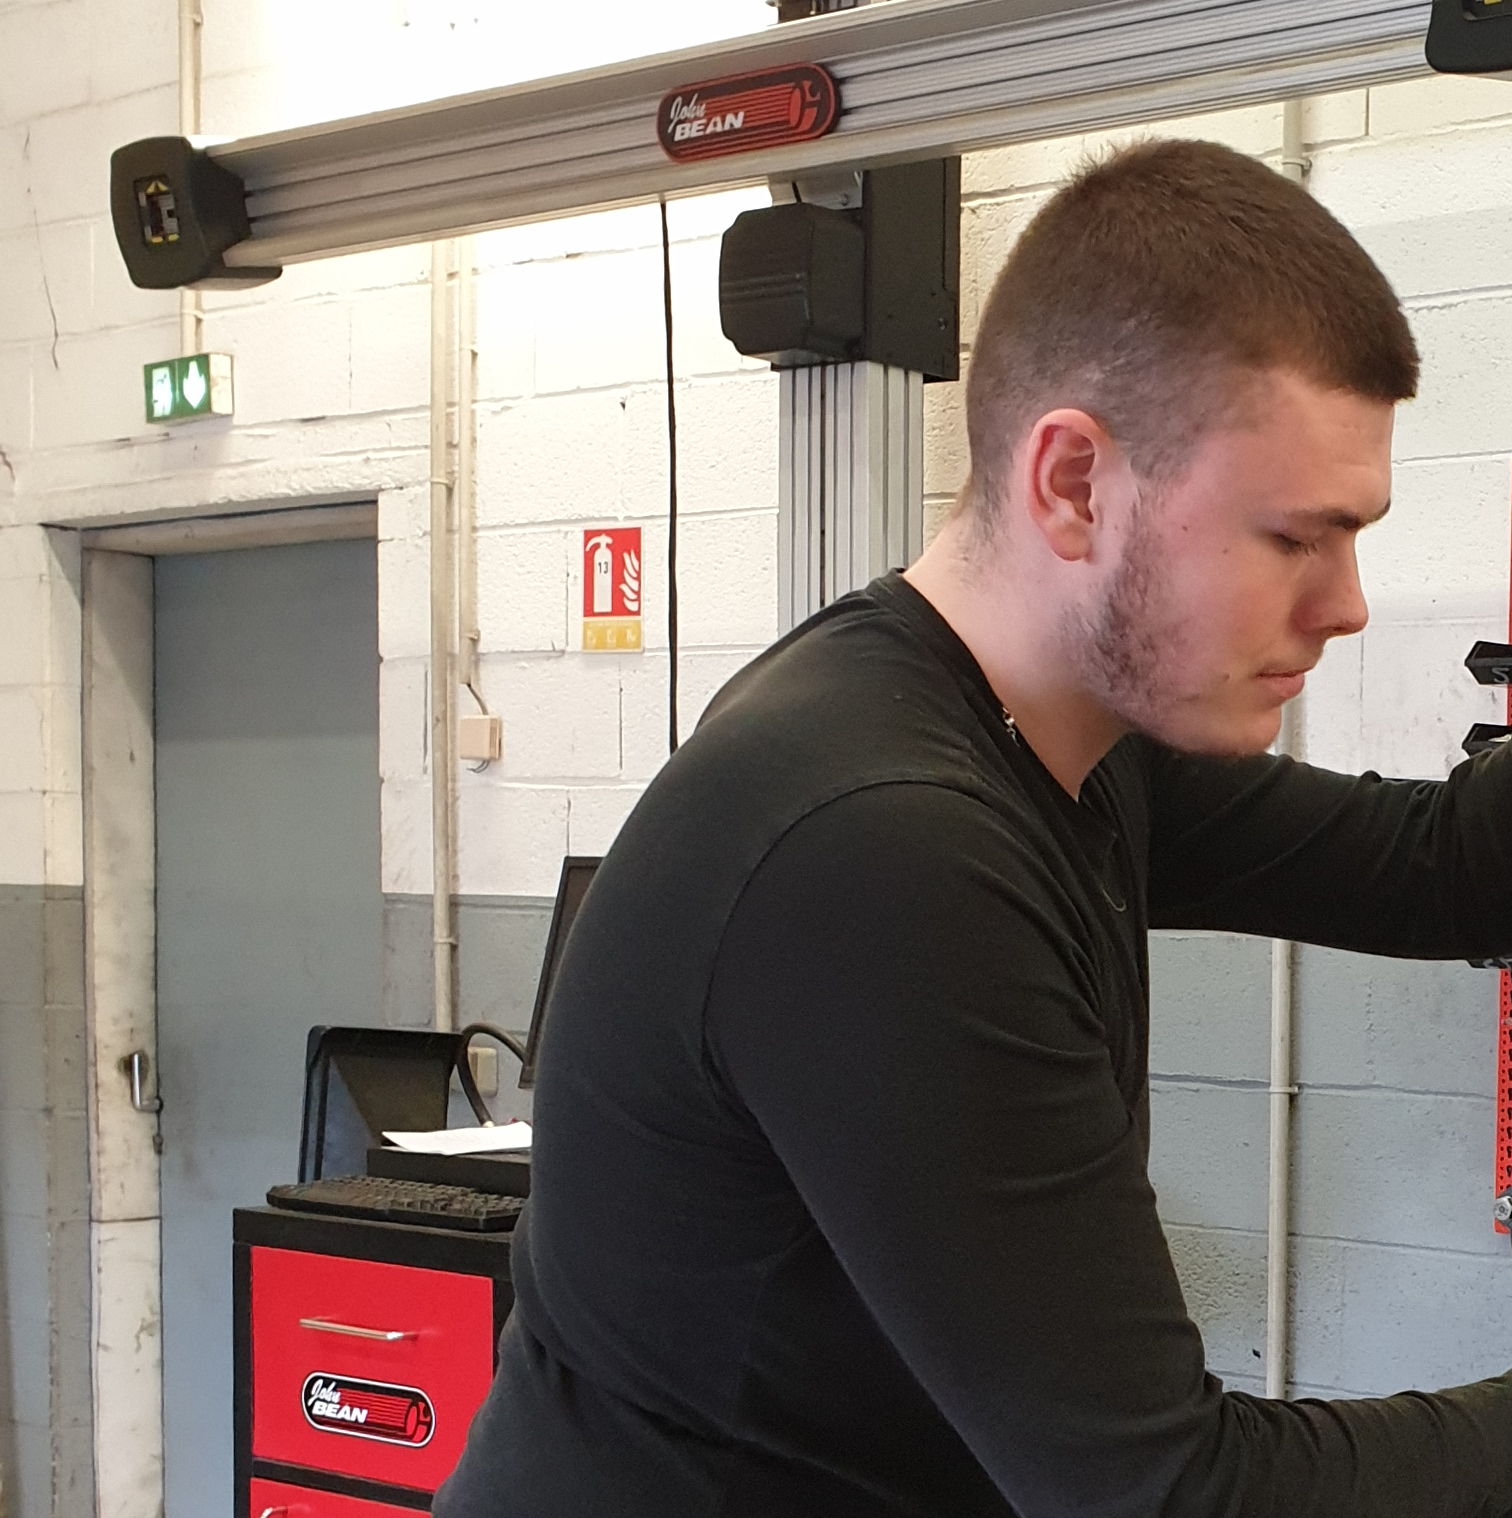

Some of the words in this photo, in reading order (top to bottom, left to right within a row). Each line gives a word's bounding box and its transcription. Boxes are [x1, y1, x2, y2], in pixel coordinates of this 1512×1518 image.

[668, 92, 707, 134] John
[673, 111, 745, 142] BEAN
[598, 561, 609, 575] 13
[307, 1379, 342, 1407] John
[311, 1399, 369, 1424] BEAN
